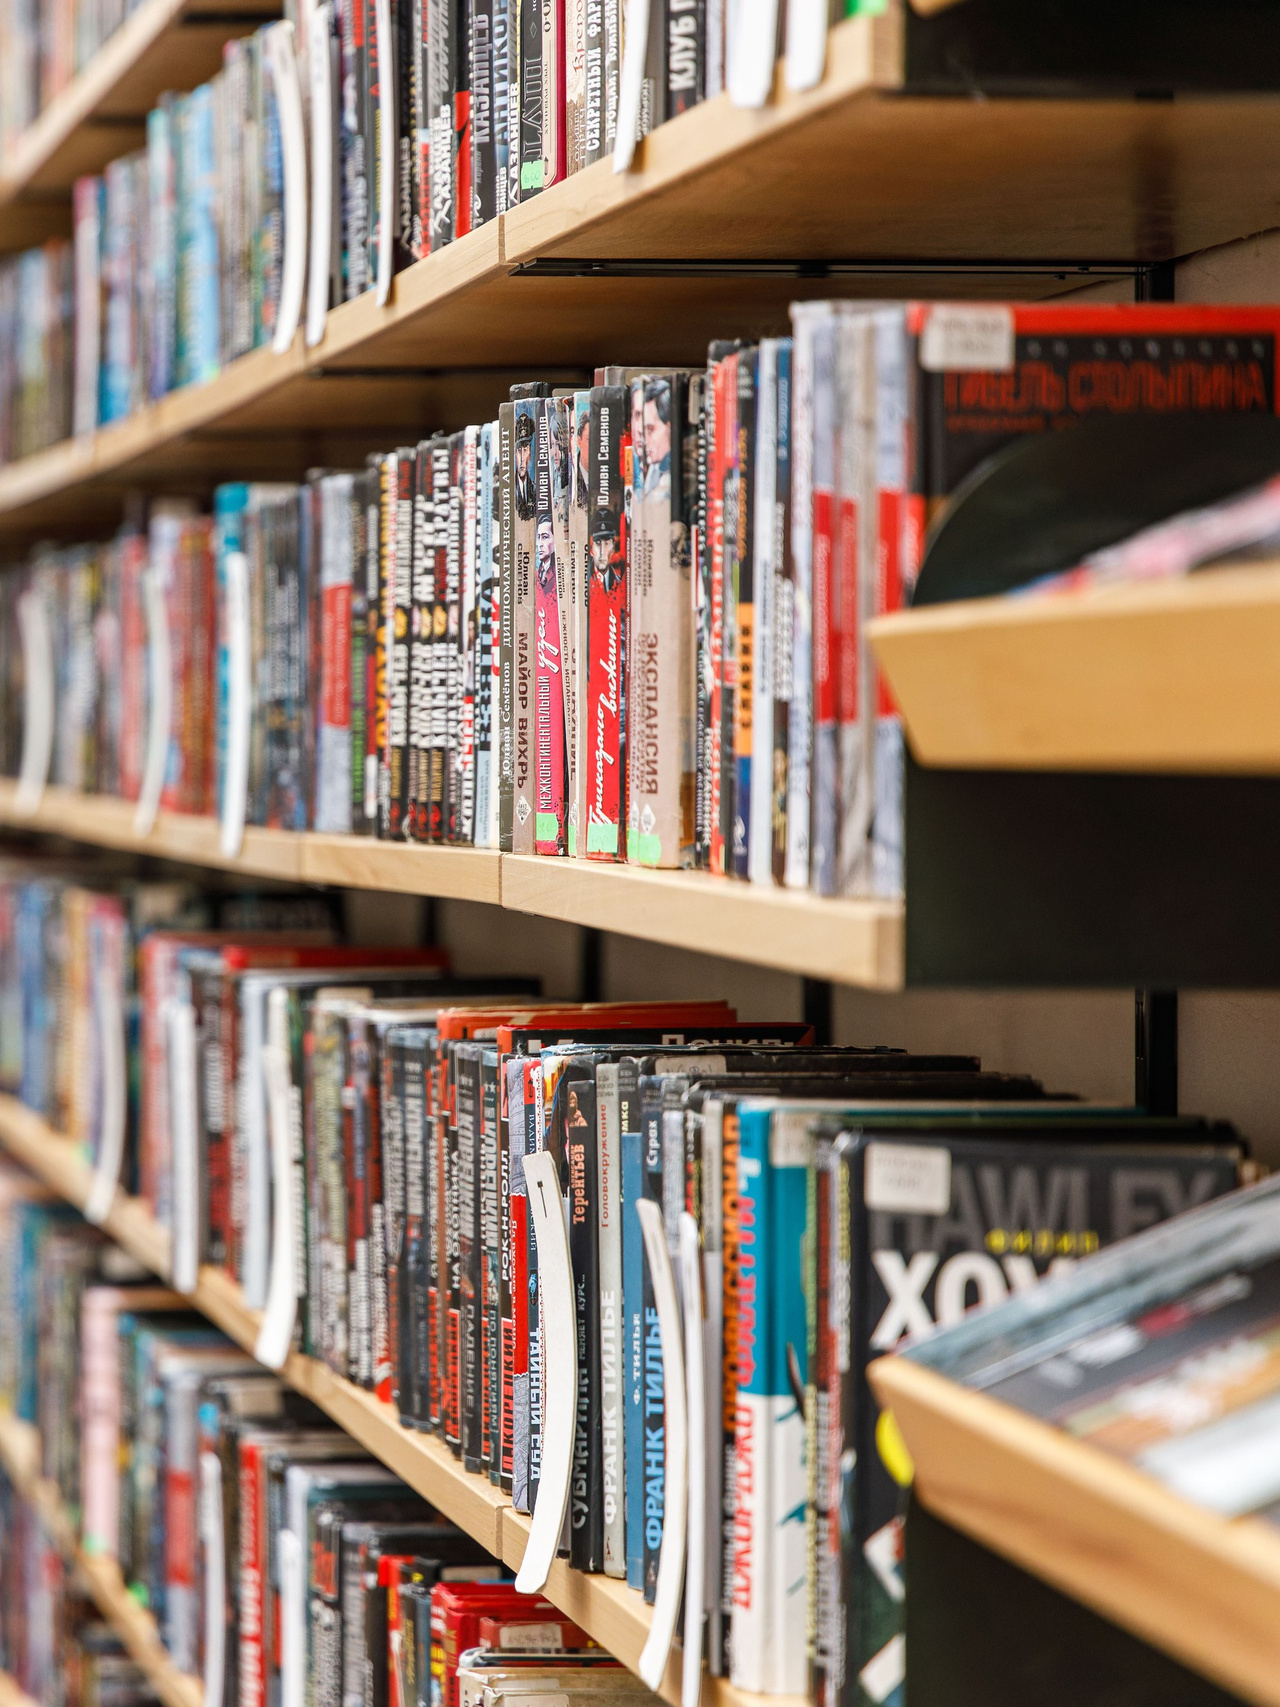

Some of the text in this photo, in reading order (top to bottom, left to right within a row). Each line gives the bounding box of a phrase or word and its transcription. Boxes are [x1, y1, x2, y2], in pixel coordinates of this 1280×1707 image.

[473, 13, 492, 144] КАЗАНЦЕВ
[585, 0, 602, 151] СЕКРЕТНЫЙ ФАР
[668, 15, 698, 91] КЛУБ
[500, 166, 508, 214] АЗАНЦЕВ
[500, 427, 510, 483] АГЕНТ
[537, 416, 550, 511] Юлиан Семенов
[597, 406, 610, 506] Юлиан Семенов
[501, 486, 511, 648] ДИПЛОМАТИЧЕСКИЙ
[522, 551, 530, 597] Юлиан
[479, 577, 492, 751] ВЗЯТКА
[516, 631, 531, 791] МАЙОР ВИХРЬ
[646, 633, 659, 796] ЭКСПАНСИЯ
[537, 676, 552, 811] МЕЖКОНТИНЕНТАЛЬНЫЙ
[484, 1120, 498, 1247] КОРЕЦКИЙ
[571, 1144, 589, 1225] Терентьев
[646, 1119, 661, 1168] Страх
[501, 1150, 509, 1282] РОК-Н-РОЛЛ
[722, 1114, 740, 1433] ПРОФЕССИОНАЛ
[466, 1304, 475, 1407] ПАДЕНИЕ
[490, 1310, 498, 1428] ПО ПОНЯТИЯМ
[599, 1104, 617, 1525] ФРАНК ТИЛЬЕ Головокружение
[632, 1313, 641, 1405] Ф. ТИЛЬЕ
[530, 1433, 541, 1481] СУД
[645, 1427, 665, 1551] ФРАНК
